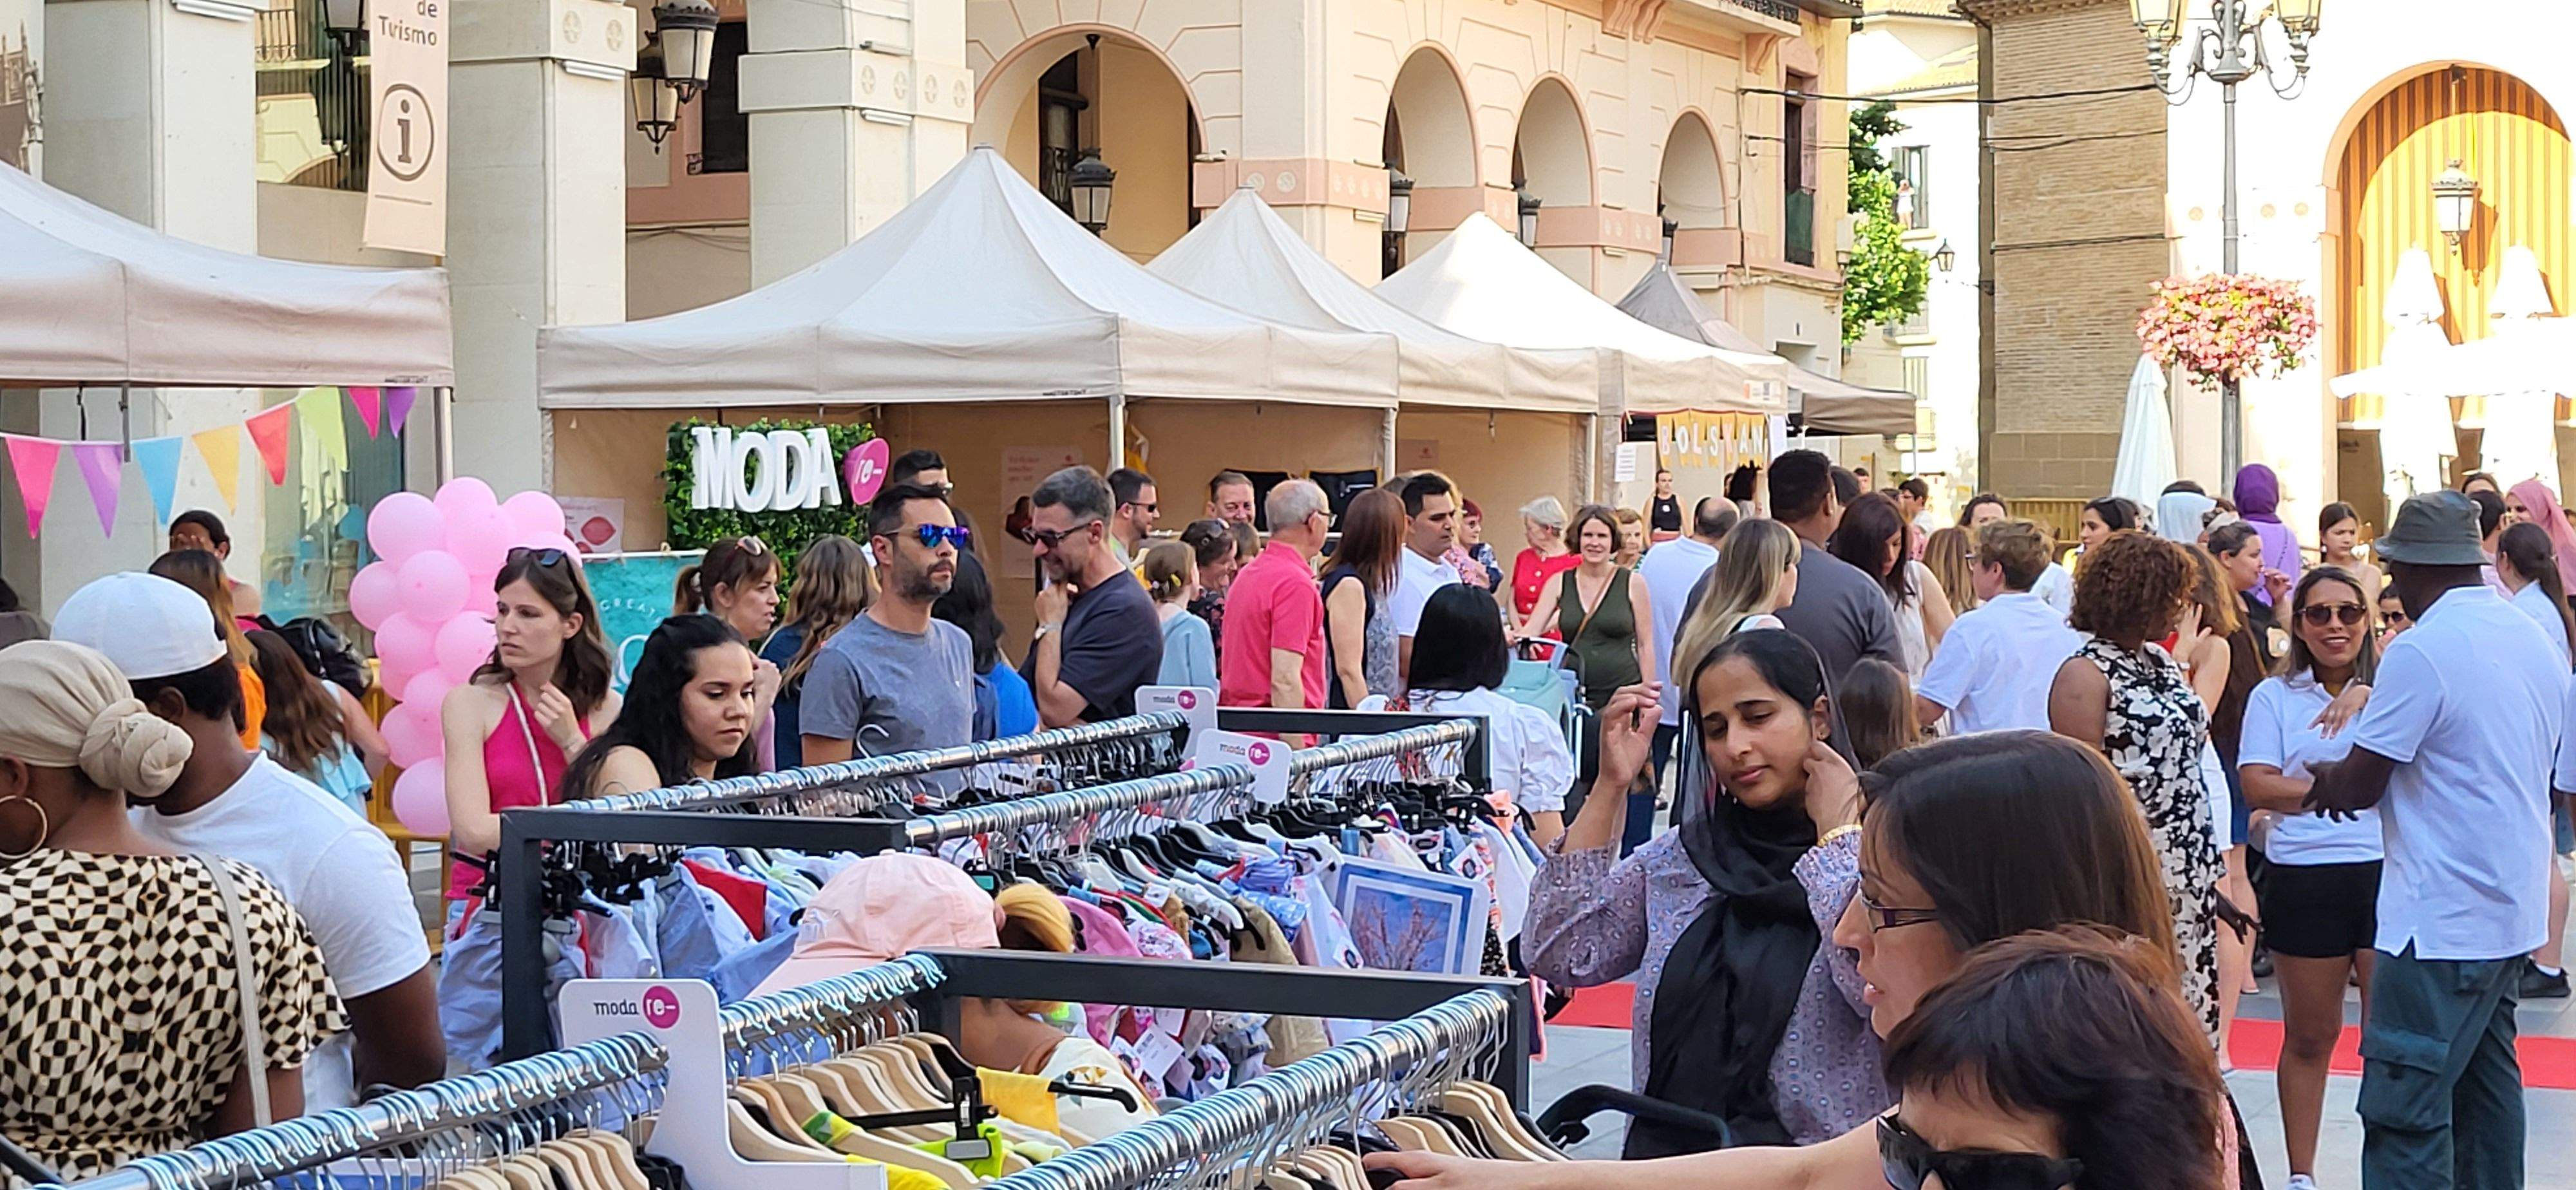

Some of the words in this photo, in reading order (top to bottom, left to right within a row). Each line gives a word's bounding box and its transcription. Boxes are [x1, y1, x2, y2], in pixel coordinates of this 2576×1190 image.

[417, 0, 437, 17] de
[378, 15, 437, 46] Turismo
[1660, 422, 1764, 457] BOLSKAN
[691, 427, 842, 513] MODA
[1220, 743, 1245, 756] moda
[593, 999, 639, 1015] moda
